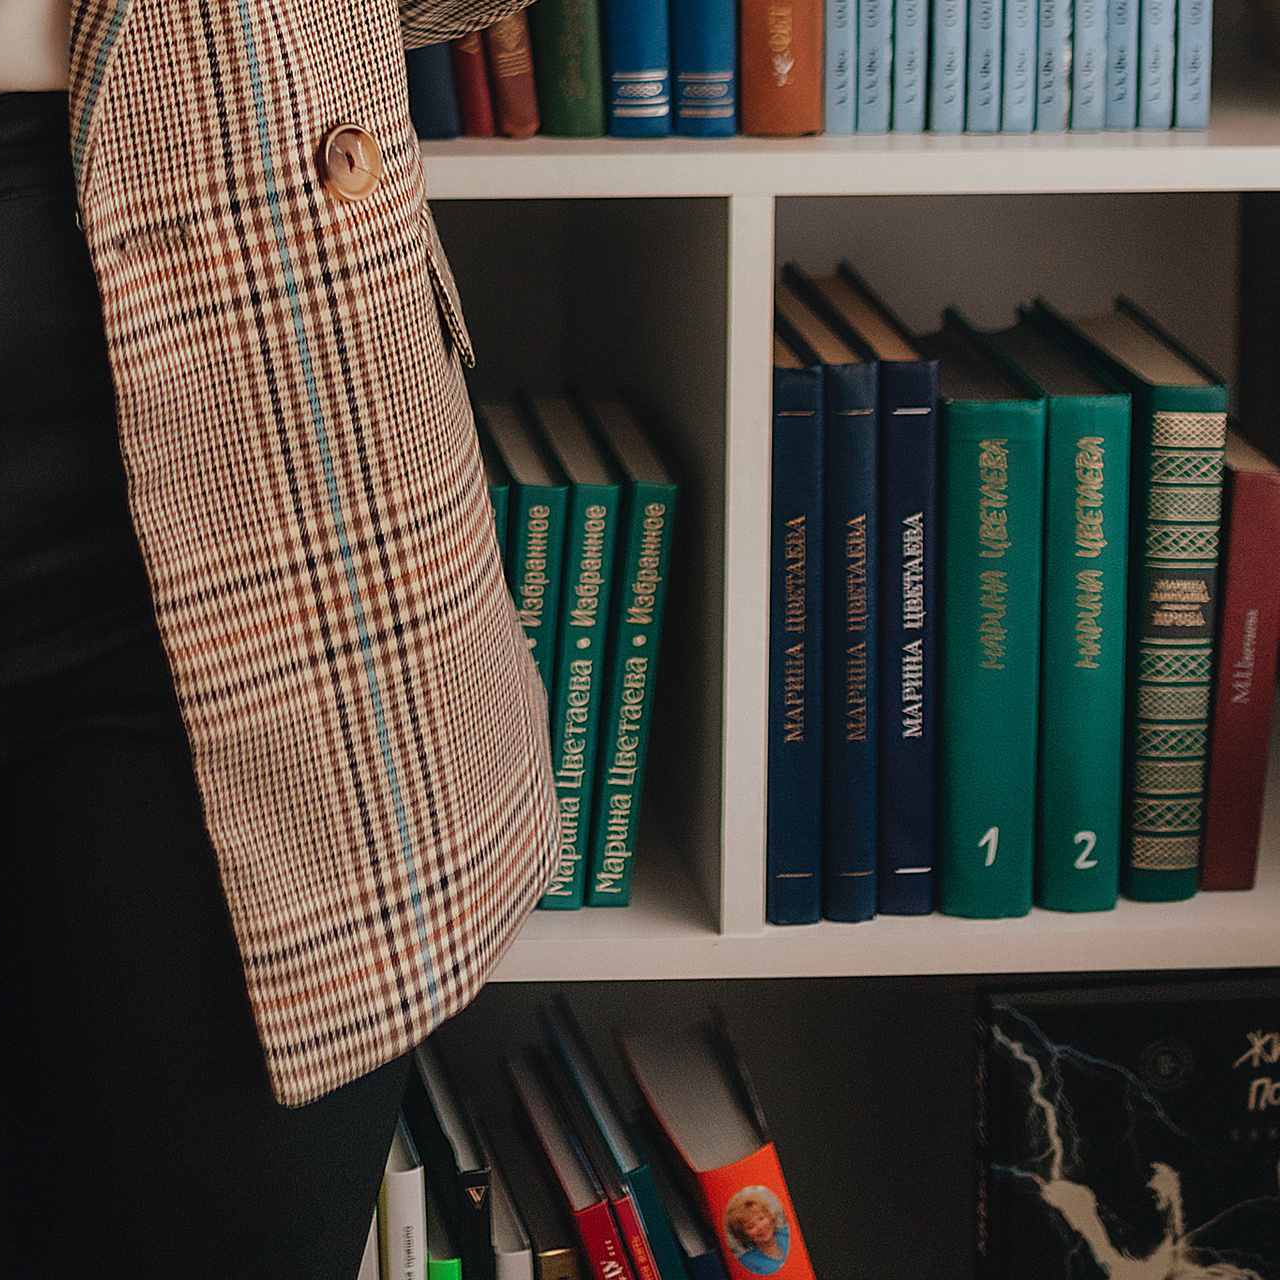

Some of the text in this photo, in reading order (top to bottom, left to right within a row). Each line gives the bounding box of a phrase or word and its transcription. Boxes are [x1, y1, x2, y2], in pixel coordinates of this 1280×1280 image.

[518, 504, 552, 628] Избранное
[782, 514, 808, 743] МАРИНА ЦВЕТАЕВА
[845, 513, 869, 742] МАРИНА ЦВЕТАЕВА
[901, 511, 926, 739] МАРИНА ЦВЕТАЕВА
[978, 439, 1011, 670] МАРИНА ЦВЕТАЕВА
[1075, 438, 1109, 669] МАРИНА ЦВЕТАЕВА
[544, 504, 608, 897] Марина Цветаева Избранное
[594, 502, 667, 894] Марина Цветаева Избранное
[978, 826, 1000, 867] 1
[1073, 830, 1099, 870] 2
